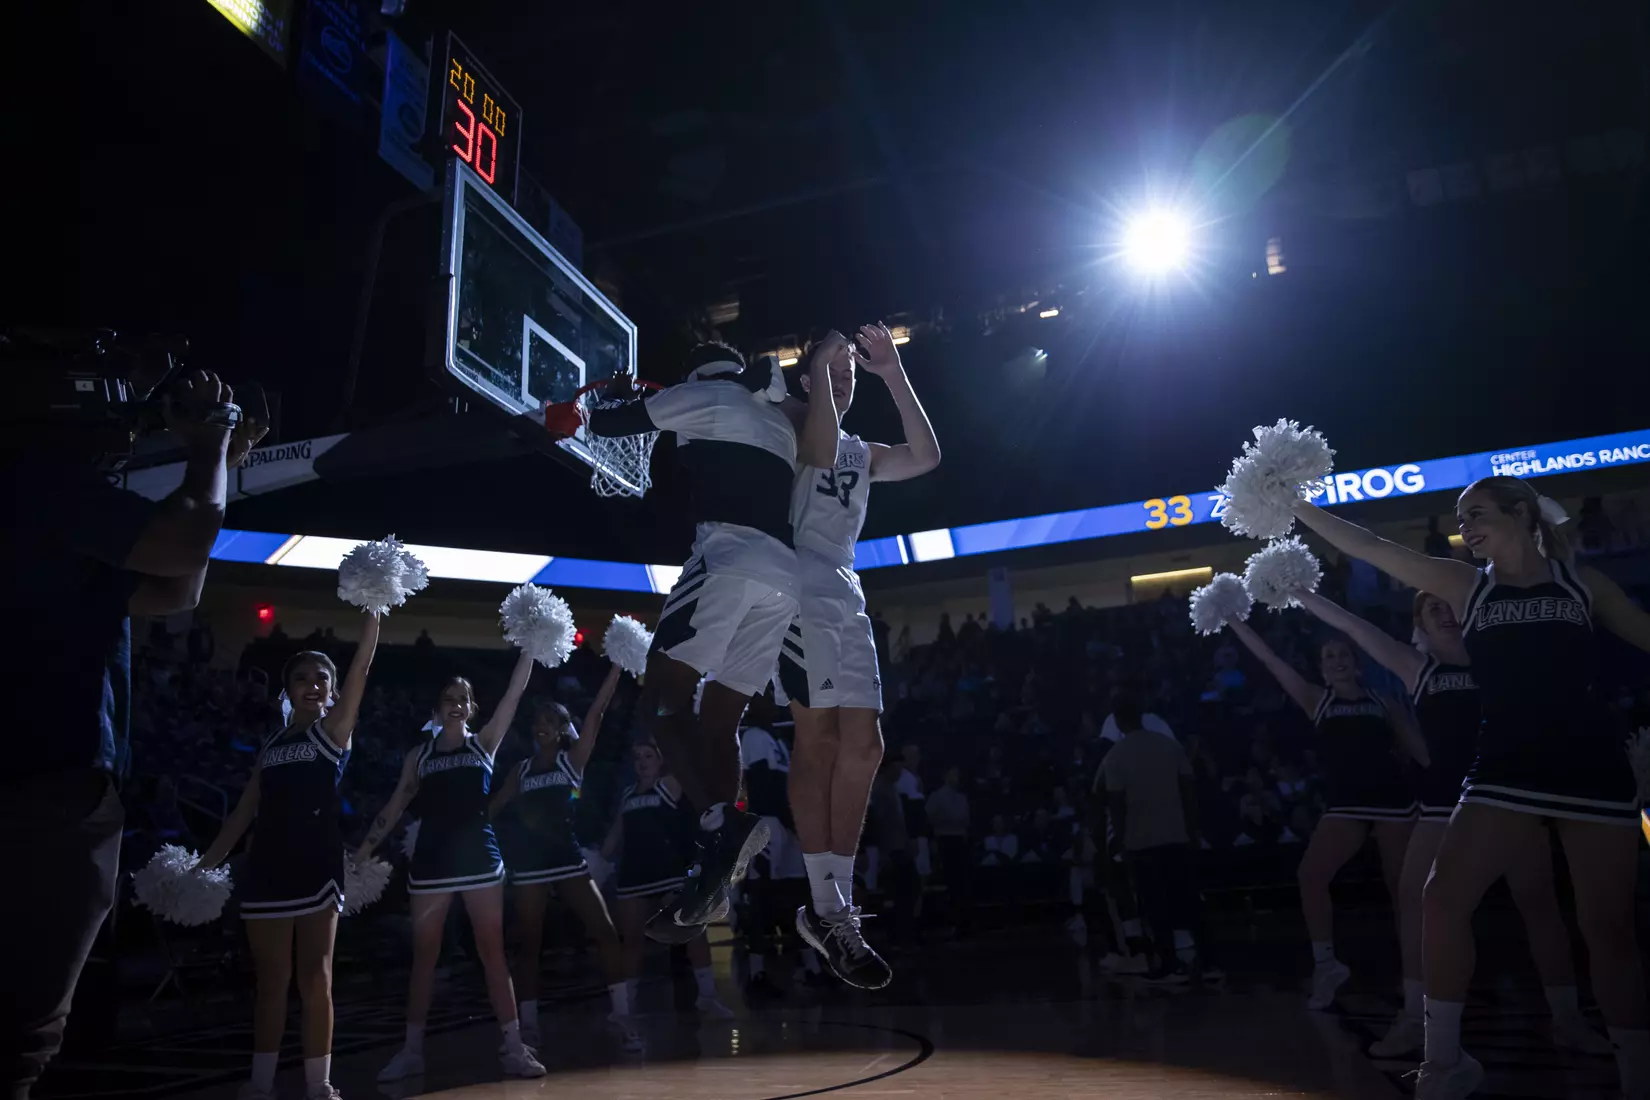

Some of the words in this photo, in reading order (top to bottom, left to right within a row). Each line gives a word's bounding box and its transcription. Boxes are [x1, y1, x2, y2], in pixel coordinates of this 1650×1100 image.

[452, 98, 497, 184] 30
[1490, 449, 1537, 465] CENTER
[1492, 452, 1598, 477] HIGHLANDS
[1143, 495, 1194, 530] 33
[1475, 597, 1587, 632] LANCERS
